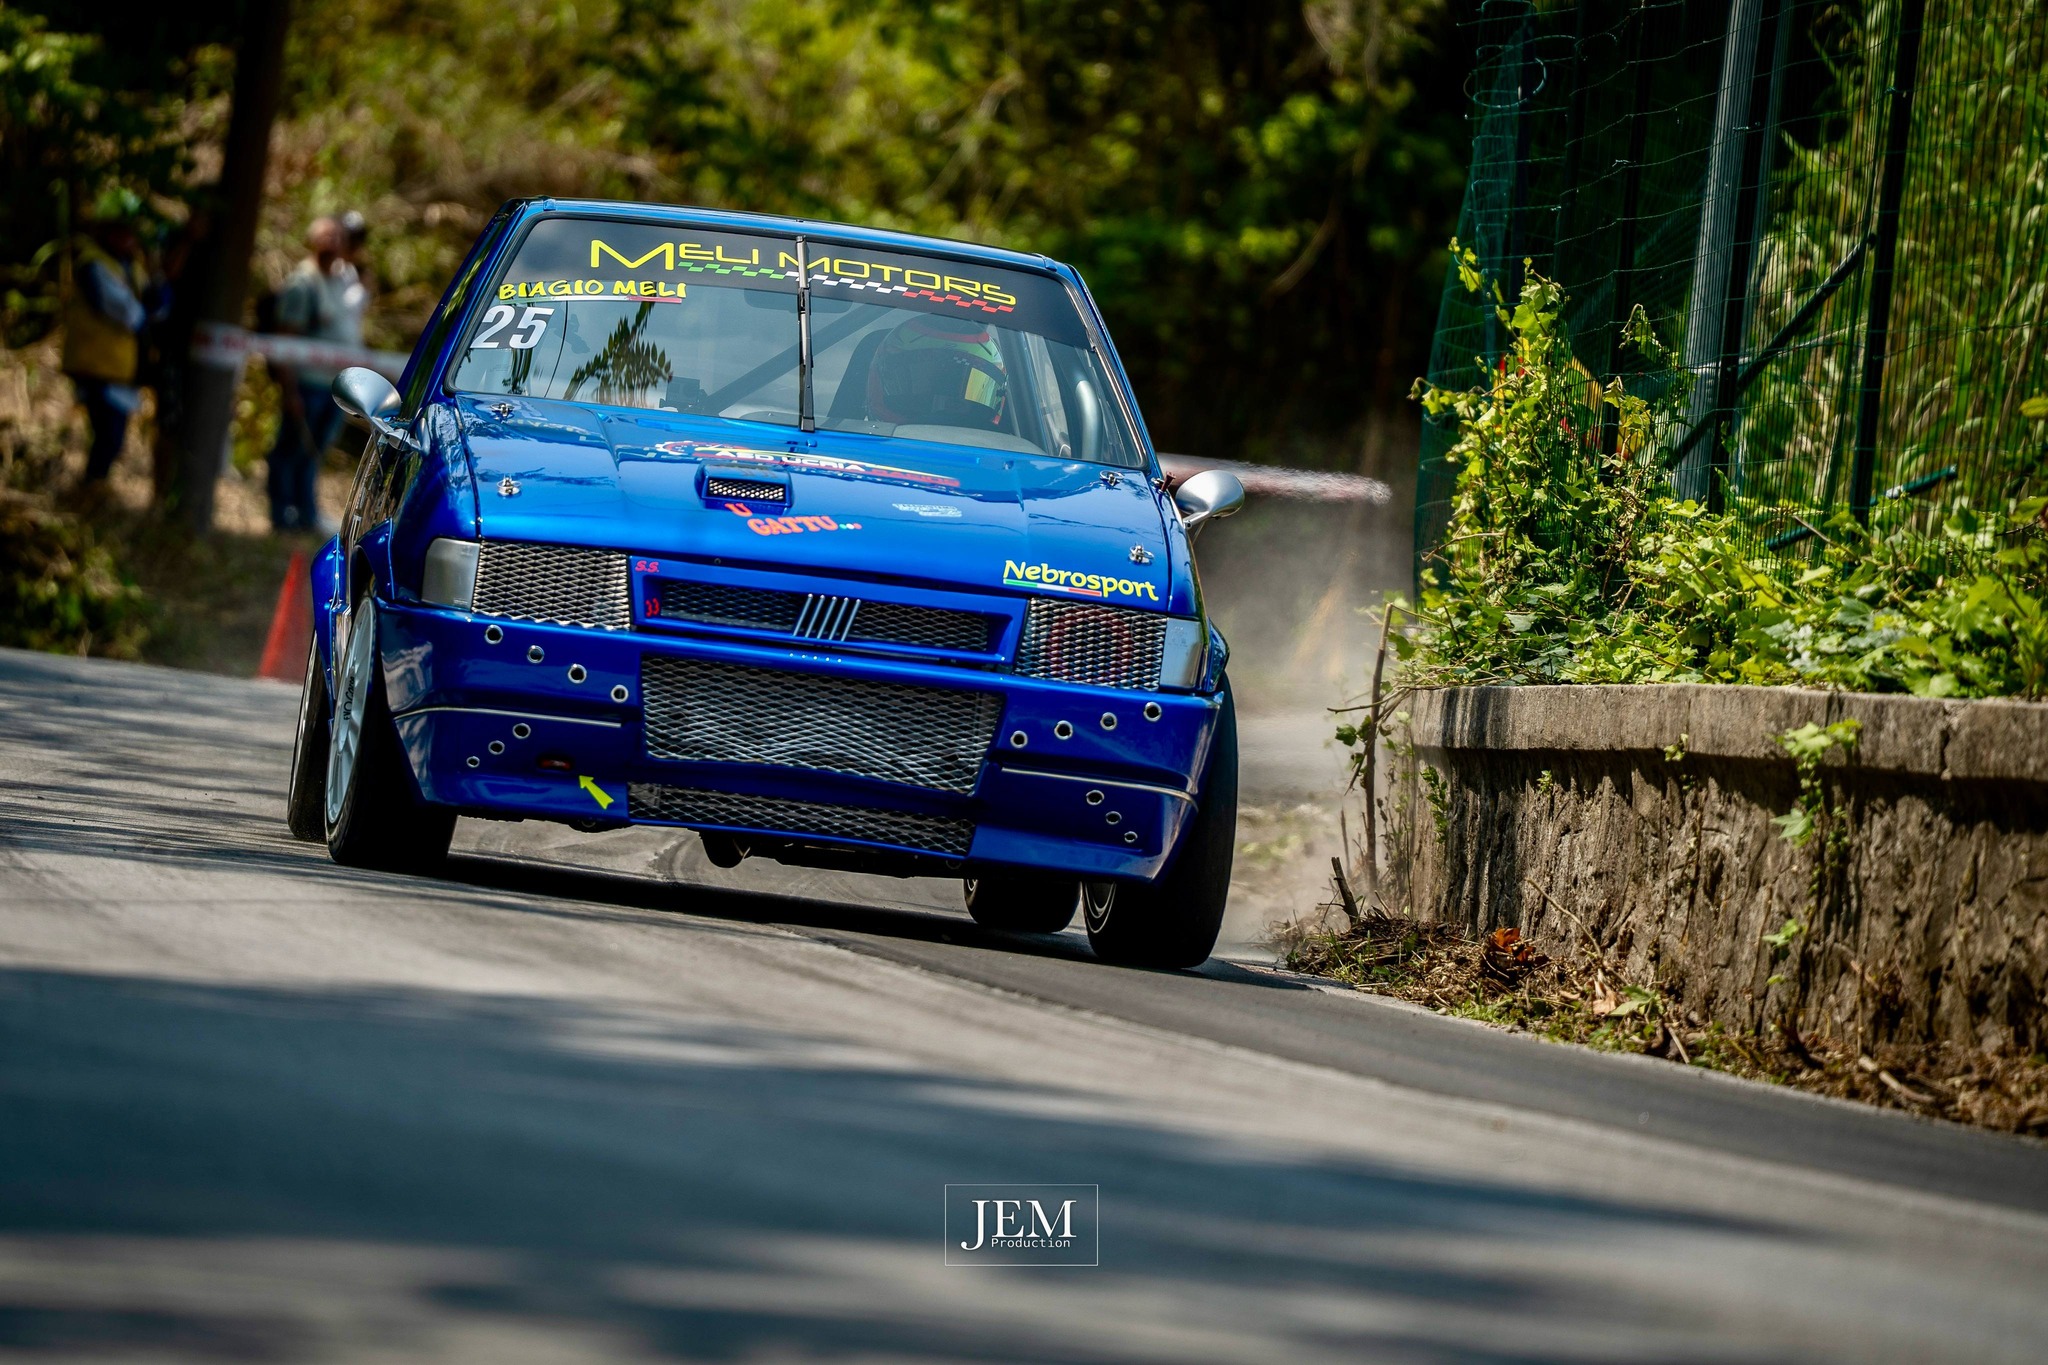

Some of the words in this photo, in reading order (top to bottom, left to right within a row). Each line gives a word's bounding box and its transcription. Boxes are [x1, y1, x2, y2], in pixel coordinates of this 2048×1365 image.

[498, 278, 605, 300] BIAGIO
[612, 279, 687, 299] MELI
[590, 239, 760, 271] MELI
[778, 251, 1017, 306] MOTORS
[469, 304, 555, 350] 25
[725, 503, 753, 517] U
[1003, 560, 1159, 601] Nebrosport
